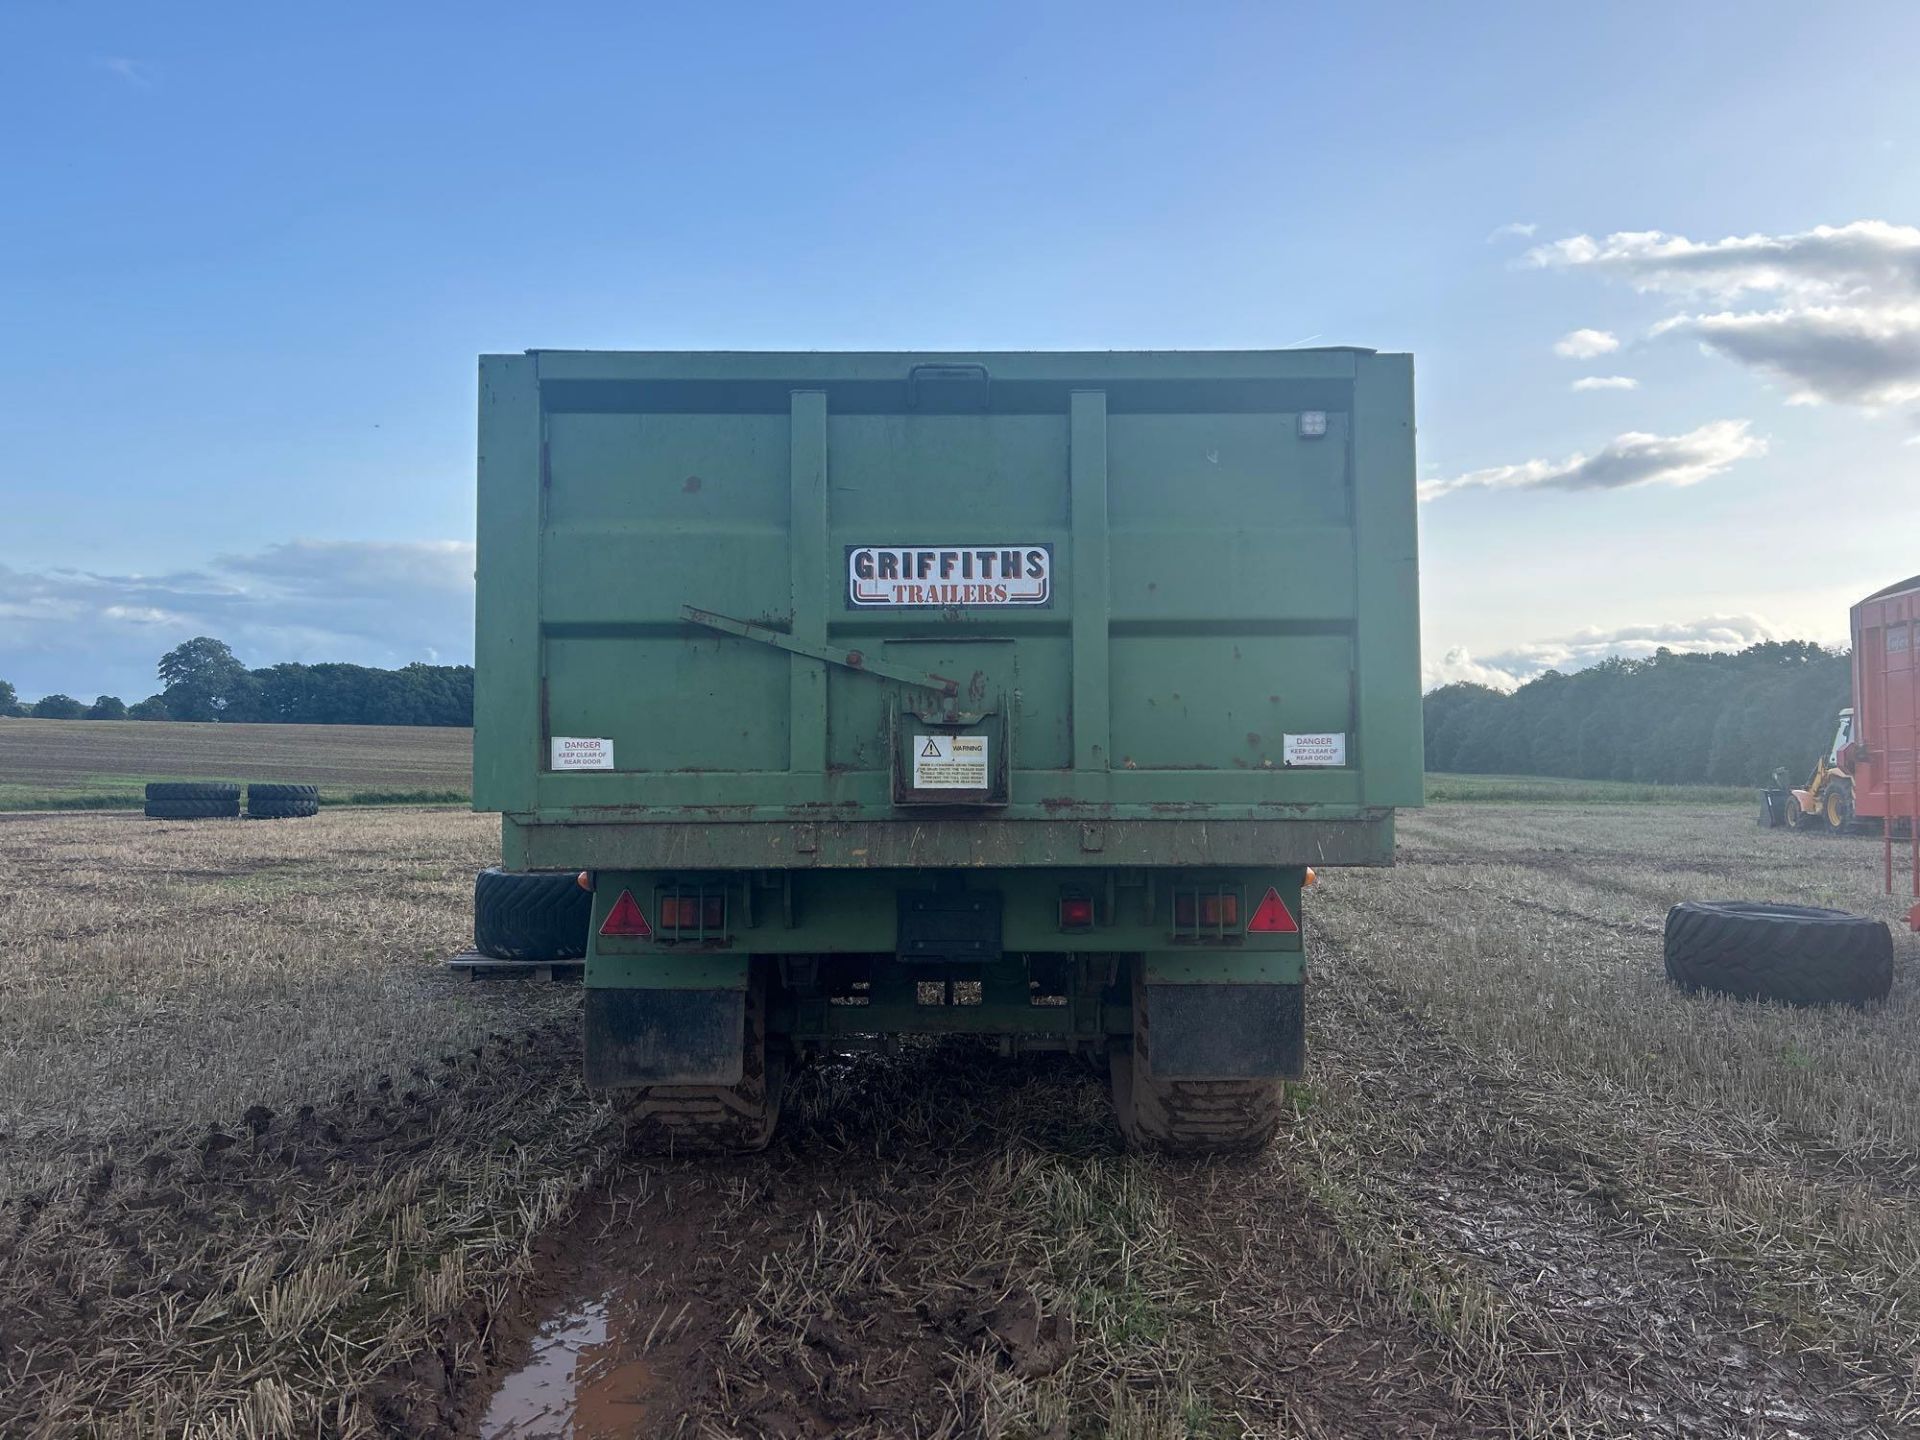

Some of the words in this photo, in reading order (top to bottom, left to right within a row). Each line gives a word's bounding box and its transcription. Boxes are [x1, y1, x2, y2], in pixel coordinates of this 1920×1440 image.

[854, 550, 1045, 580] GRIFFITHS
[892, 584, 1008, 603] TRAILERS
[564, 741, 601, 749] DANGER
